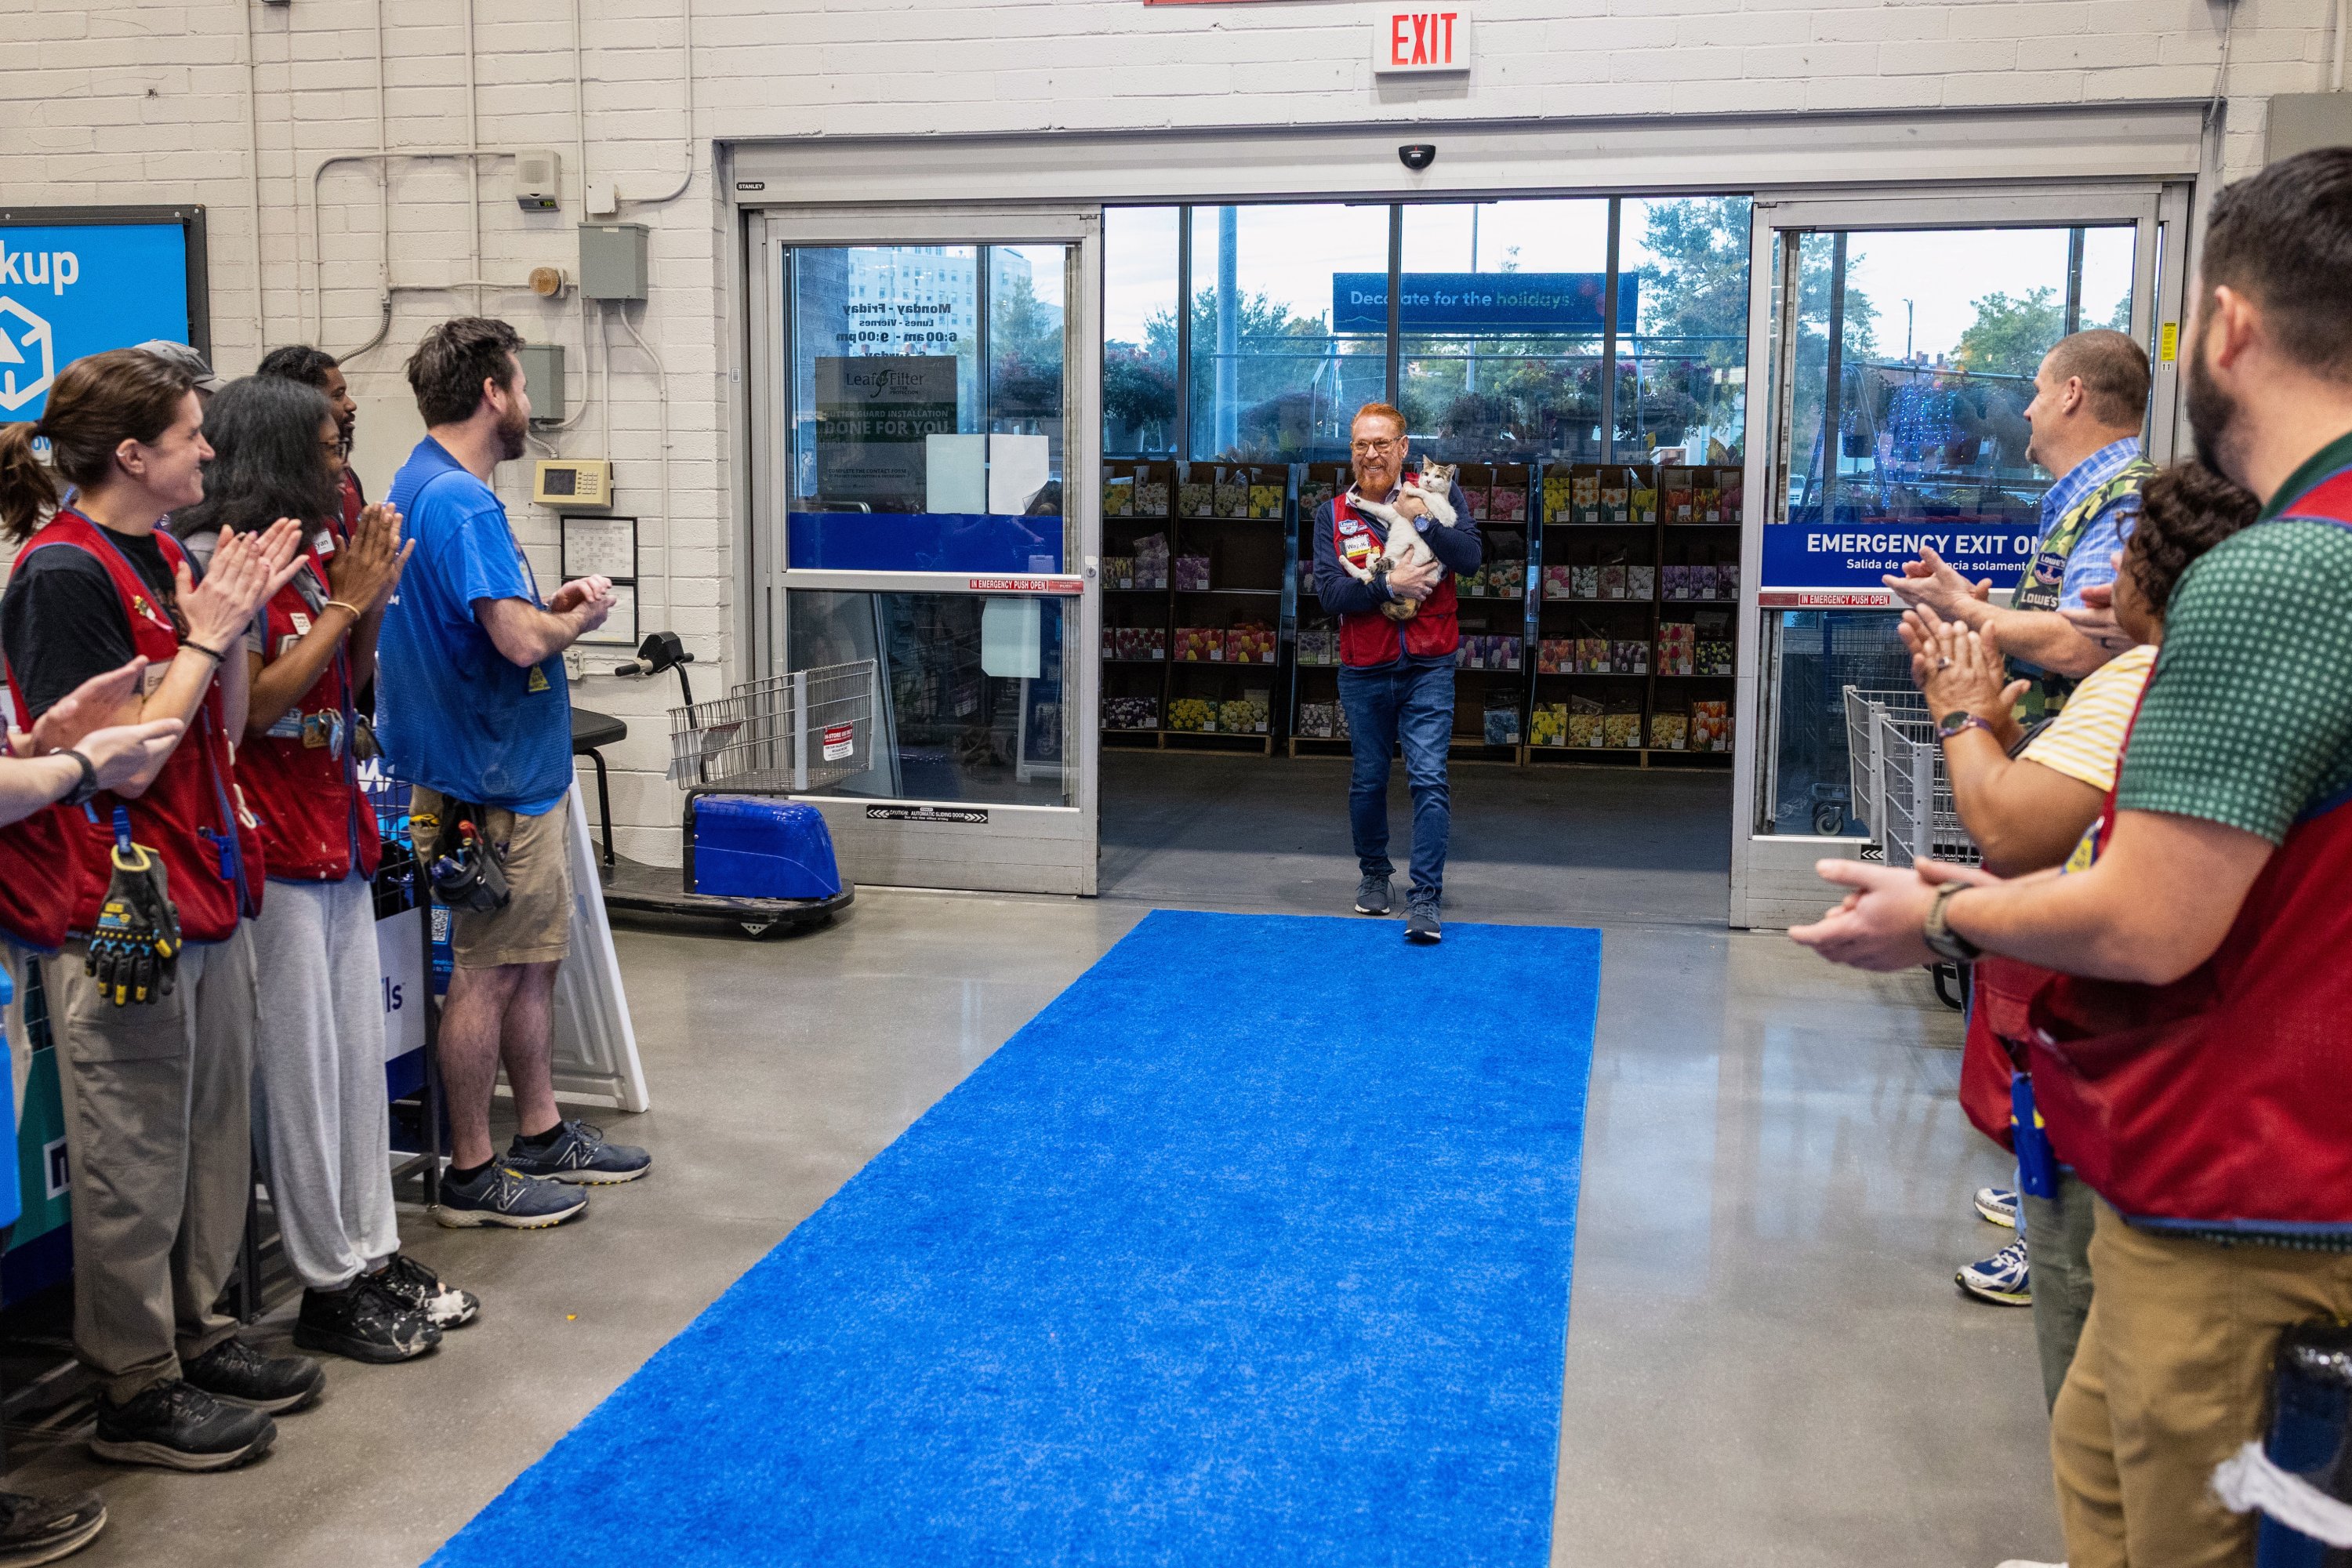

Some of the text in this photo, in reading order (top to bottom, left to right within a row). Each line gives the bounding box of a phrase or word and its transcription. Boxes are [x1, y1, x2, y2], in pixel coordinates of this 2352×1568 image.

[1392, 13, 1457, 65] EXIT
[1350, 291, 1429, 305] Decoate
[1433, 291, 1459, 305] for
[1462, 291, 1492, 305] the
[847, 372, 924, 386] Leaf Filter
[824, 421, 949, 435] DONE FOR YOU
[1807, 533, 1950, 554] EMERGENCY
[1955, 535, 2008, 554] EXIT
[1846, 558, 1882, 569] Salida
[1885, 559, 1899, 569] de
[971, 579, 1045, 590] IN EMERGENCY PUSH OPEN
[1801, 595, 1808, 604] IN
[1809, 594, 1849, 604] EMERGENCY
[1851, 595, 1868, 604] PUSH
[1871, 595, 1888, 604] OPEN
[2021, 590, 2058, 608] LOWE'S
